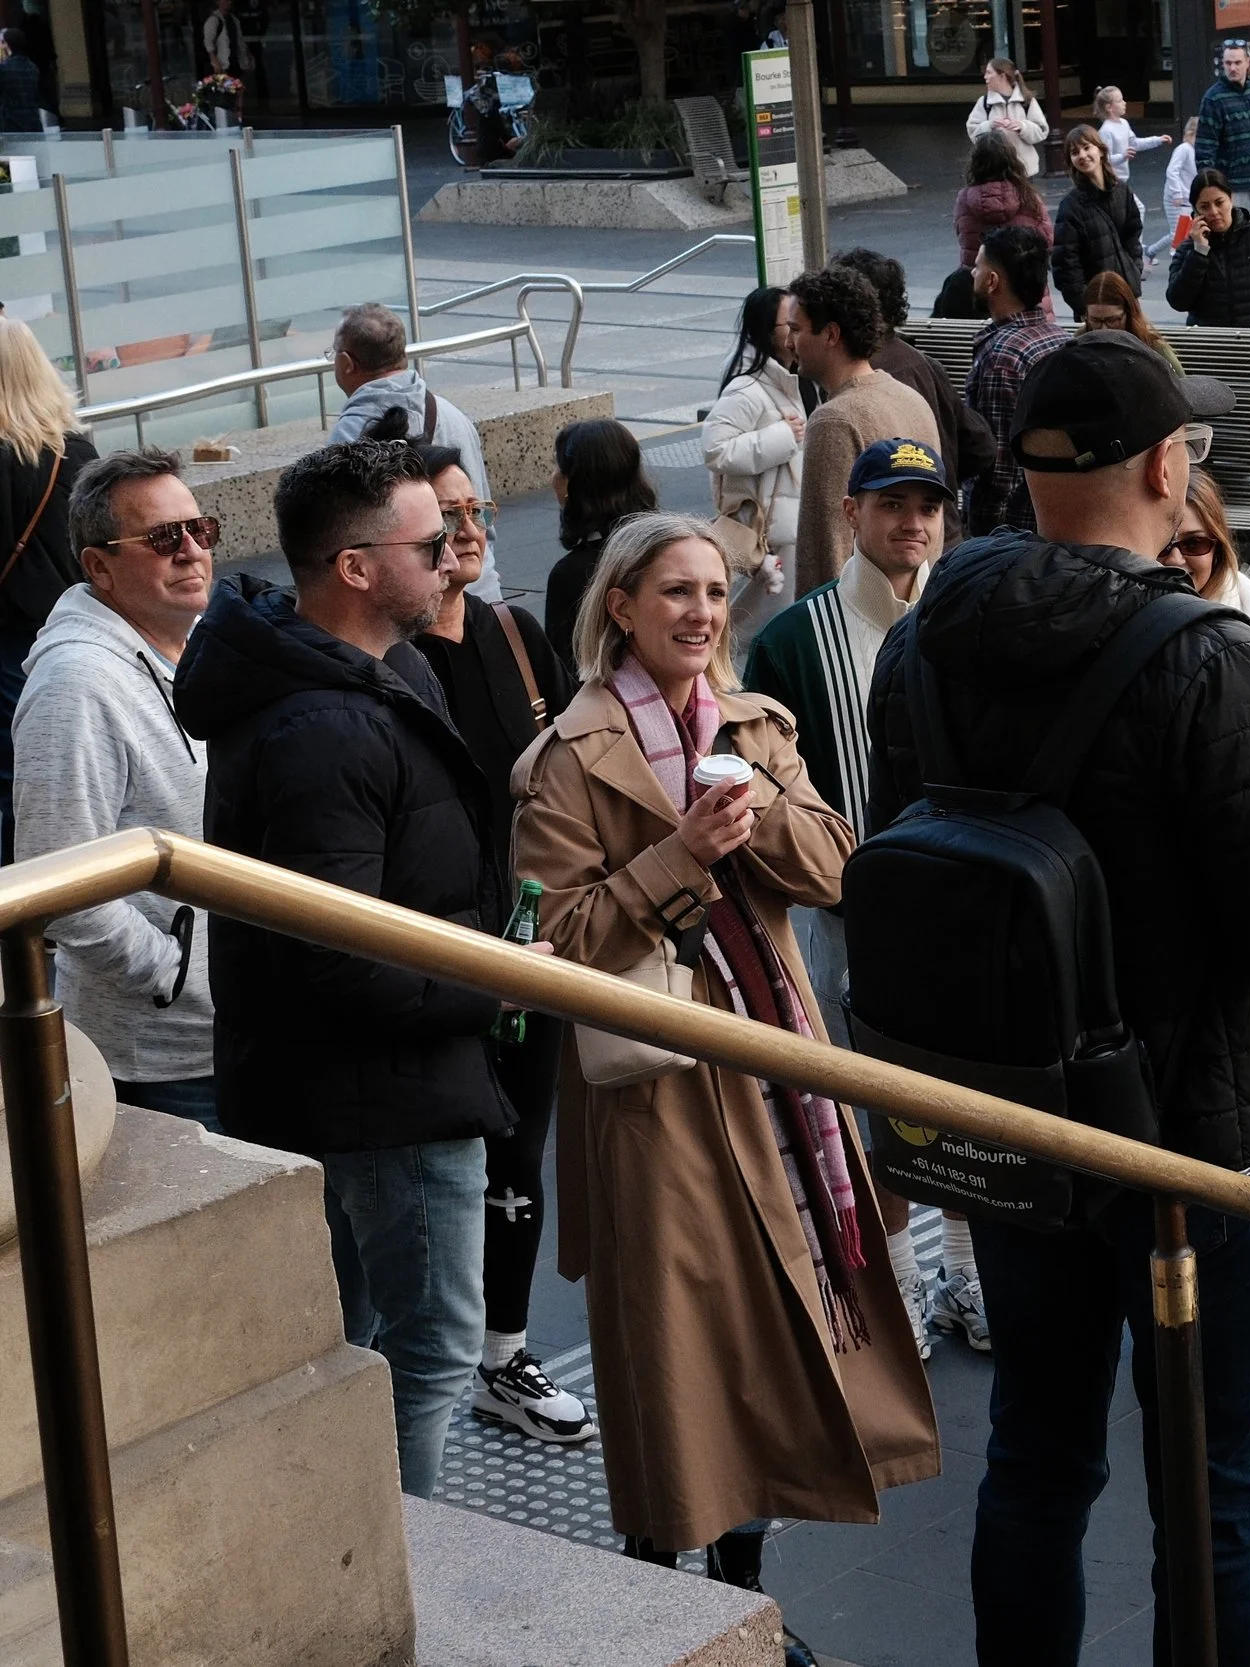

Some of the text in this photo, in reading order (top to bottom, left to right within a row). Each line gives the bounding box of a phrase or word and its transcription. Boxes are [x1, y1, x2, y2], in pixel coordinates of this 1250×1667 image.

[755, 71, 782, 81] Bourke
[941, 1140, 1028, 1165] melbourne
[886, 1164, 1033, 1210] www.walkmelbourne.com.au
[912, 1157, 988, 1189] +61 411 182 911
